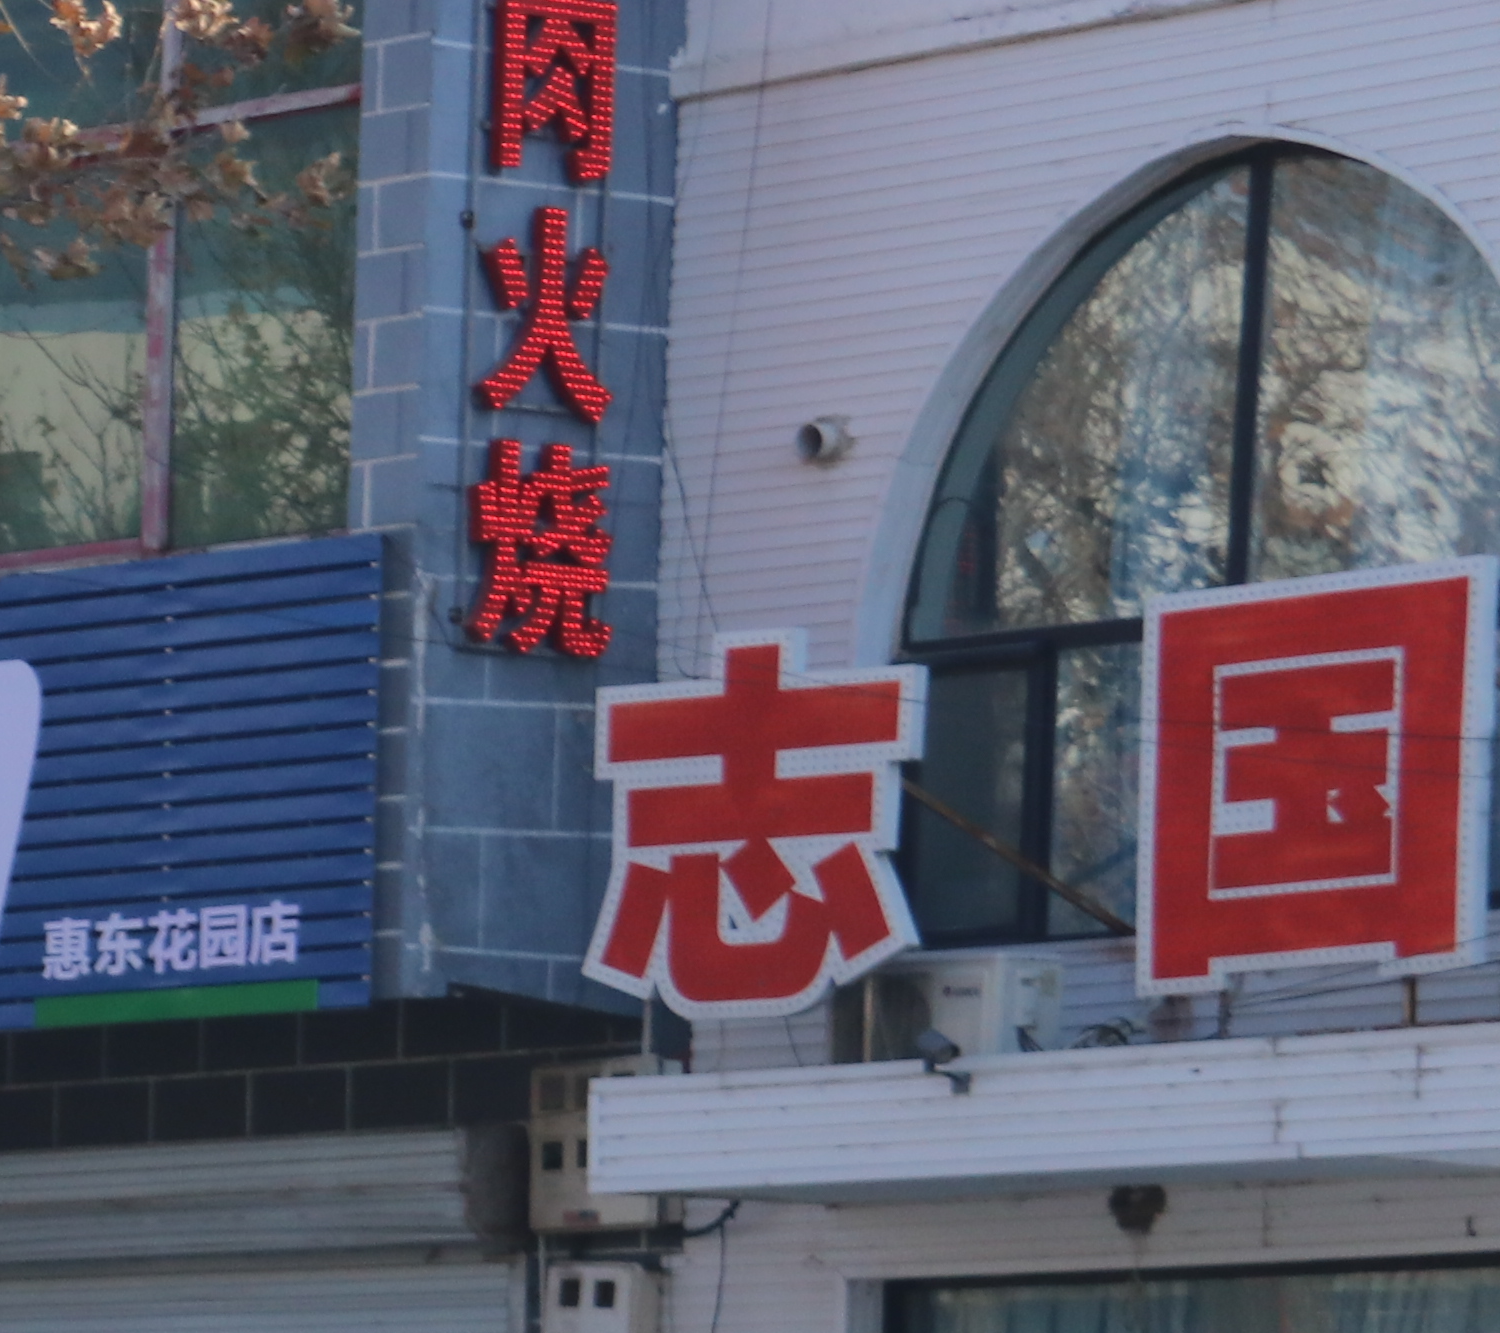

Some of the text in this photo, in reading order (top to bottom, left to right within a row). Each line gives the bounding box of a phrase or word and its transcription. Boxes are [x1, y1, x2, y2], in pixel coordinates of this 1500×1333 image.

[470, 0, 617, 658] 肉火烧
[42, 901, 300, 982] 惠东花园店
